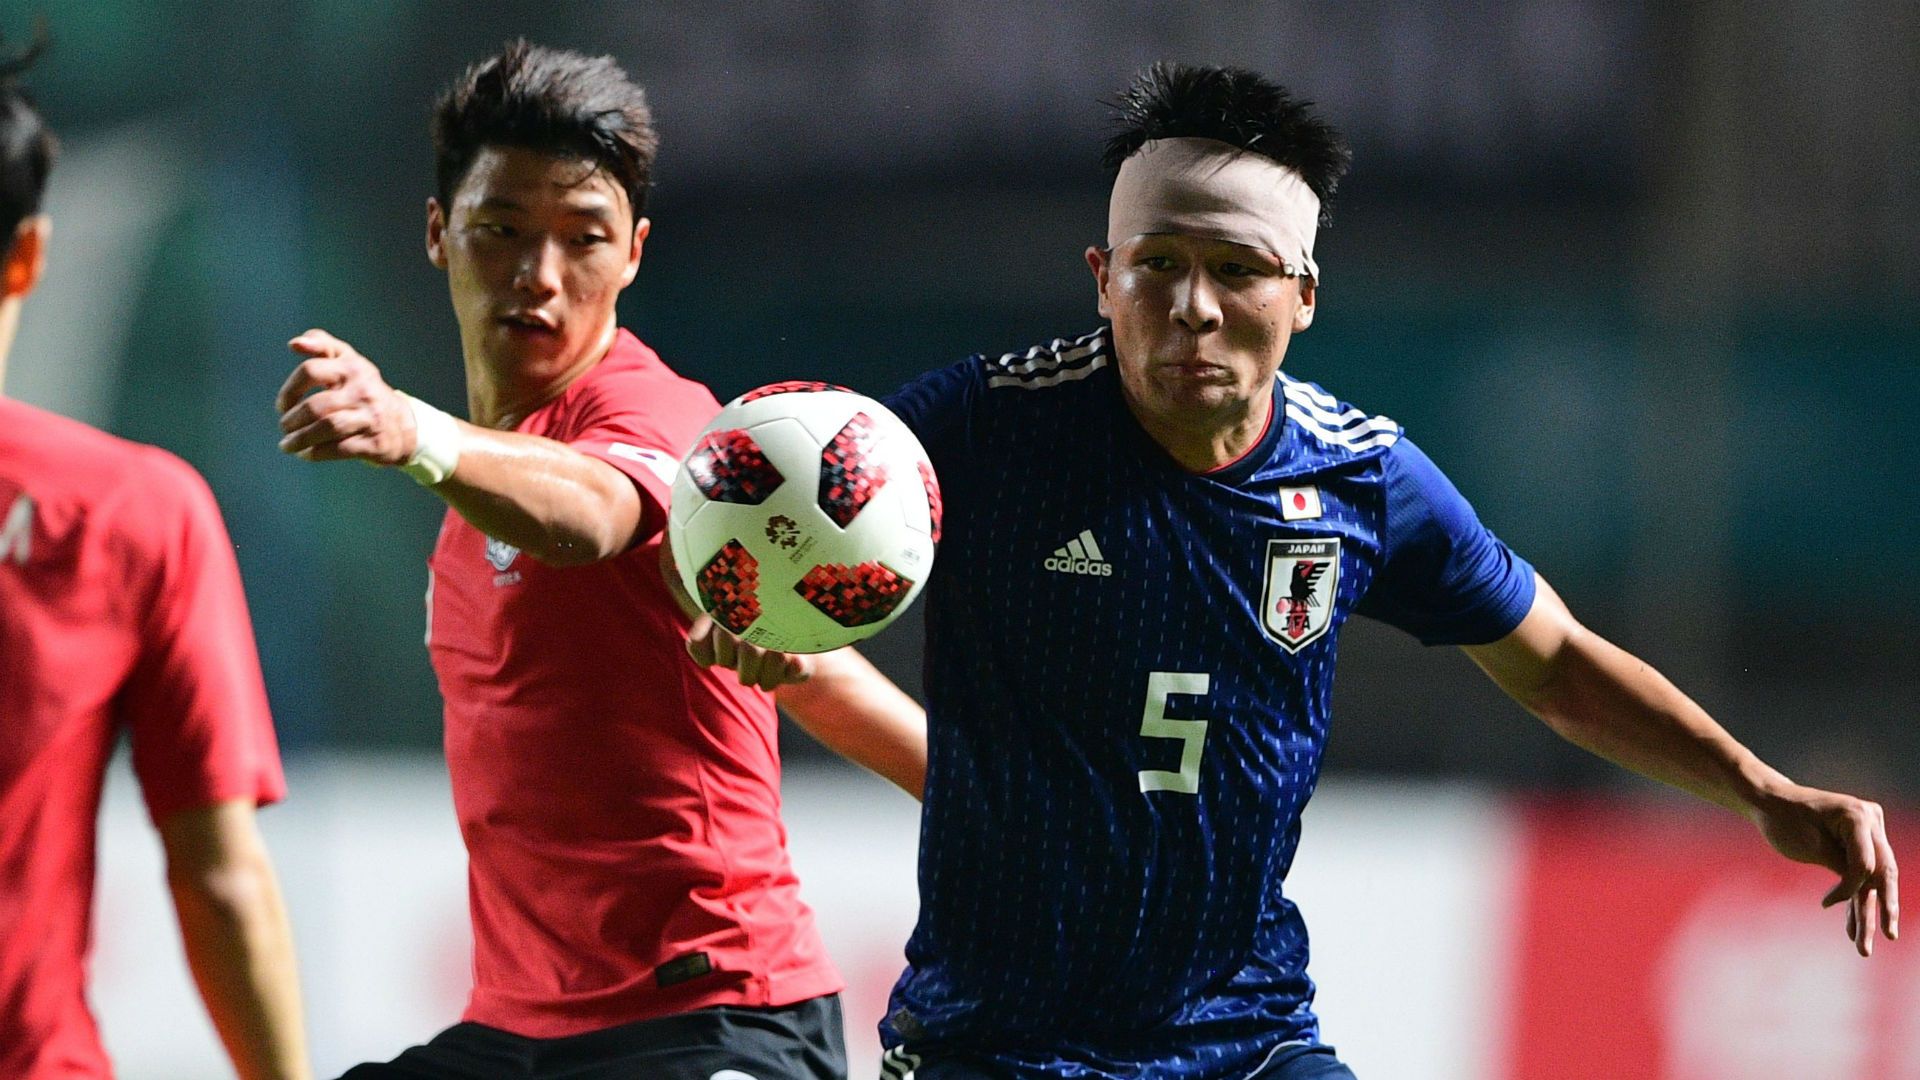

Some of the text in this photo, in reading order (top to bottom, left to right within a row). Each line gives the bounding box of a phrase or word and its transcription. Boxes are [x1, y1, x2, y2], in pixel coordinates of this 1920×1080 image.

[1288, 544, 1326, 554] JAPAN
[1044, 556, 1113, 577] adidas
[1138, 672, 1210, 794] 5
